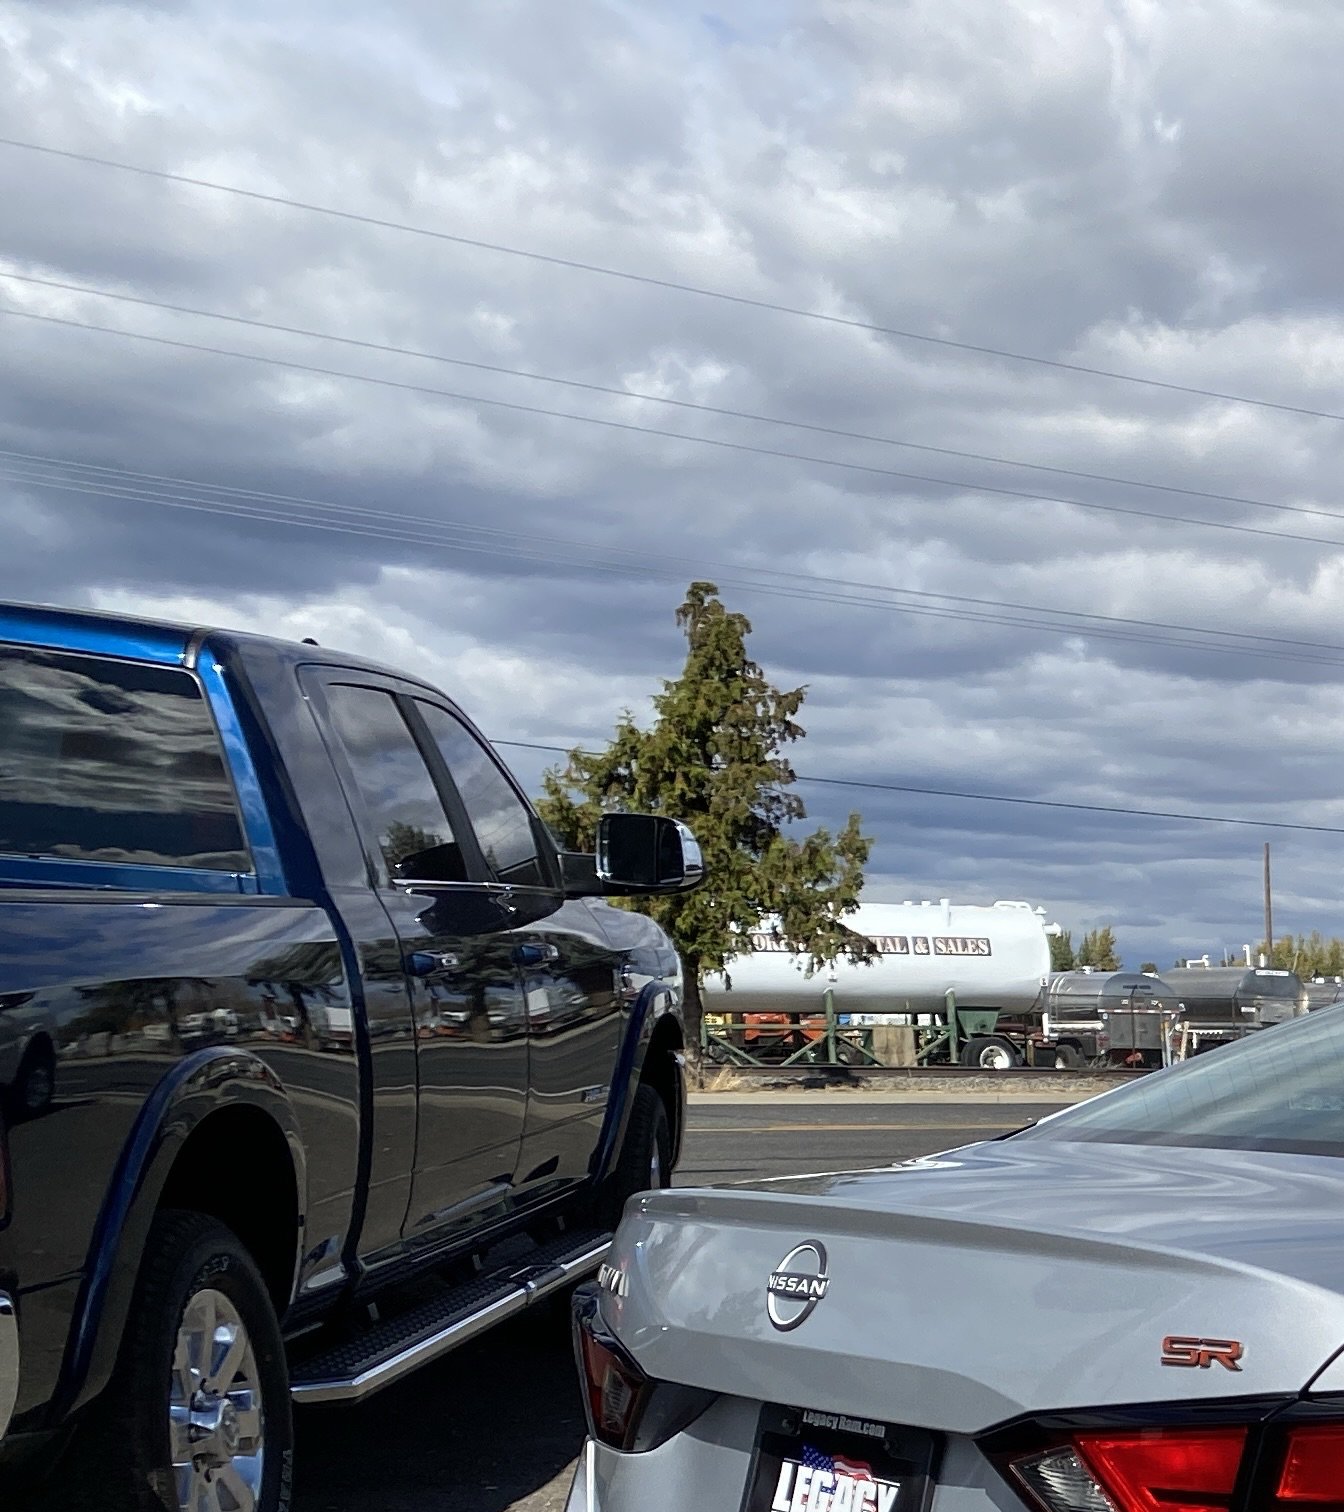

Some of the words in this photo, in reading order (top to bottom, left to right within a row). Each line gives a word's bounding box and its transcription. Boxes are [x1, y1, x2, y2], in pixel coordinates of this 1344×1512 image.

[913, 938, 929, 954] &
[935, 939, 990, 955] SALES
[767, 1274, 826, 1296] NISSAN
[1160, 1336, 1244, 1372] SR
[803, 1410, 838, 1430] Legacy
